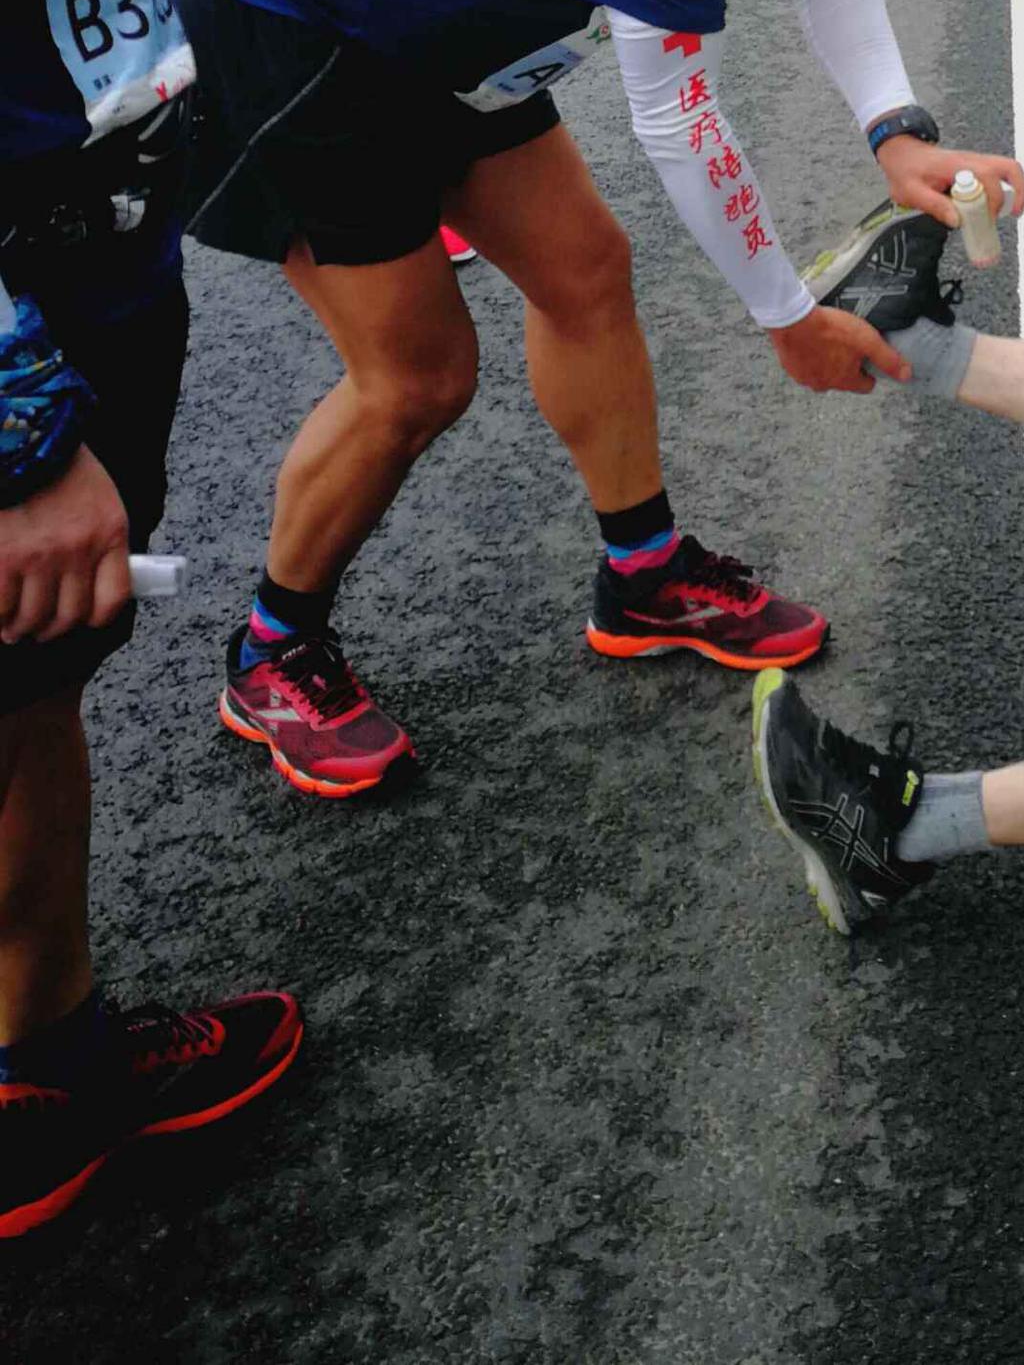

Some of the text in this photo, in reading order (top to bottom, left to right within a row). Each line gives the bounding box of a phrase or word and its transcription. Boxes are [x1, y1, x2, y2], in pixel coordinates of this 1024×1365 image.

[679, 68, 773, 261] 医疗陪跑员
